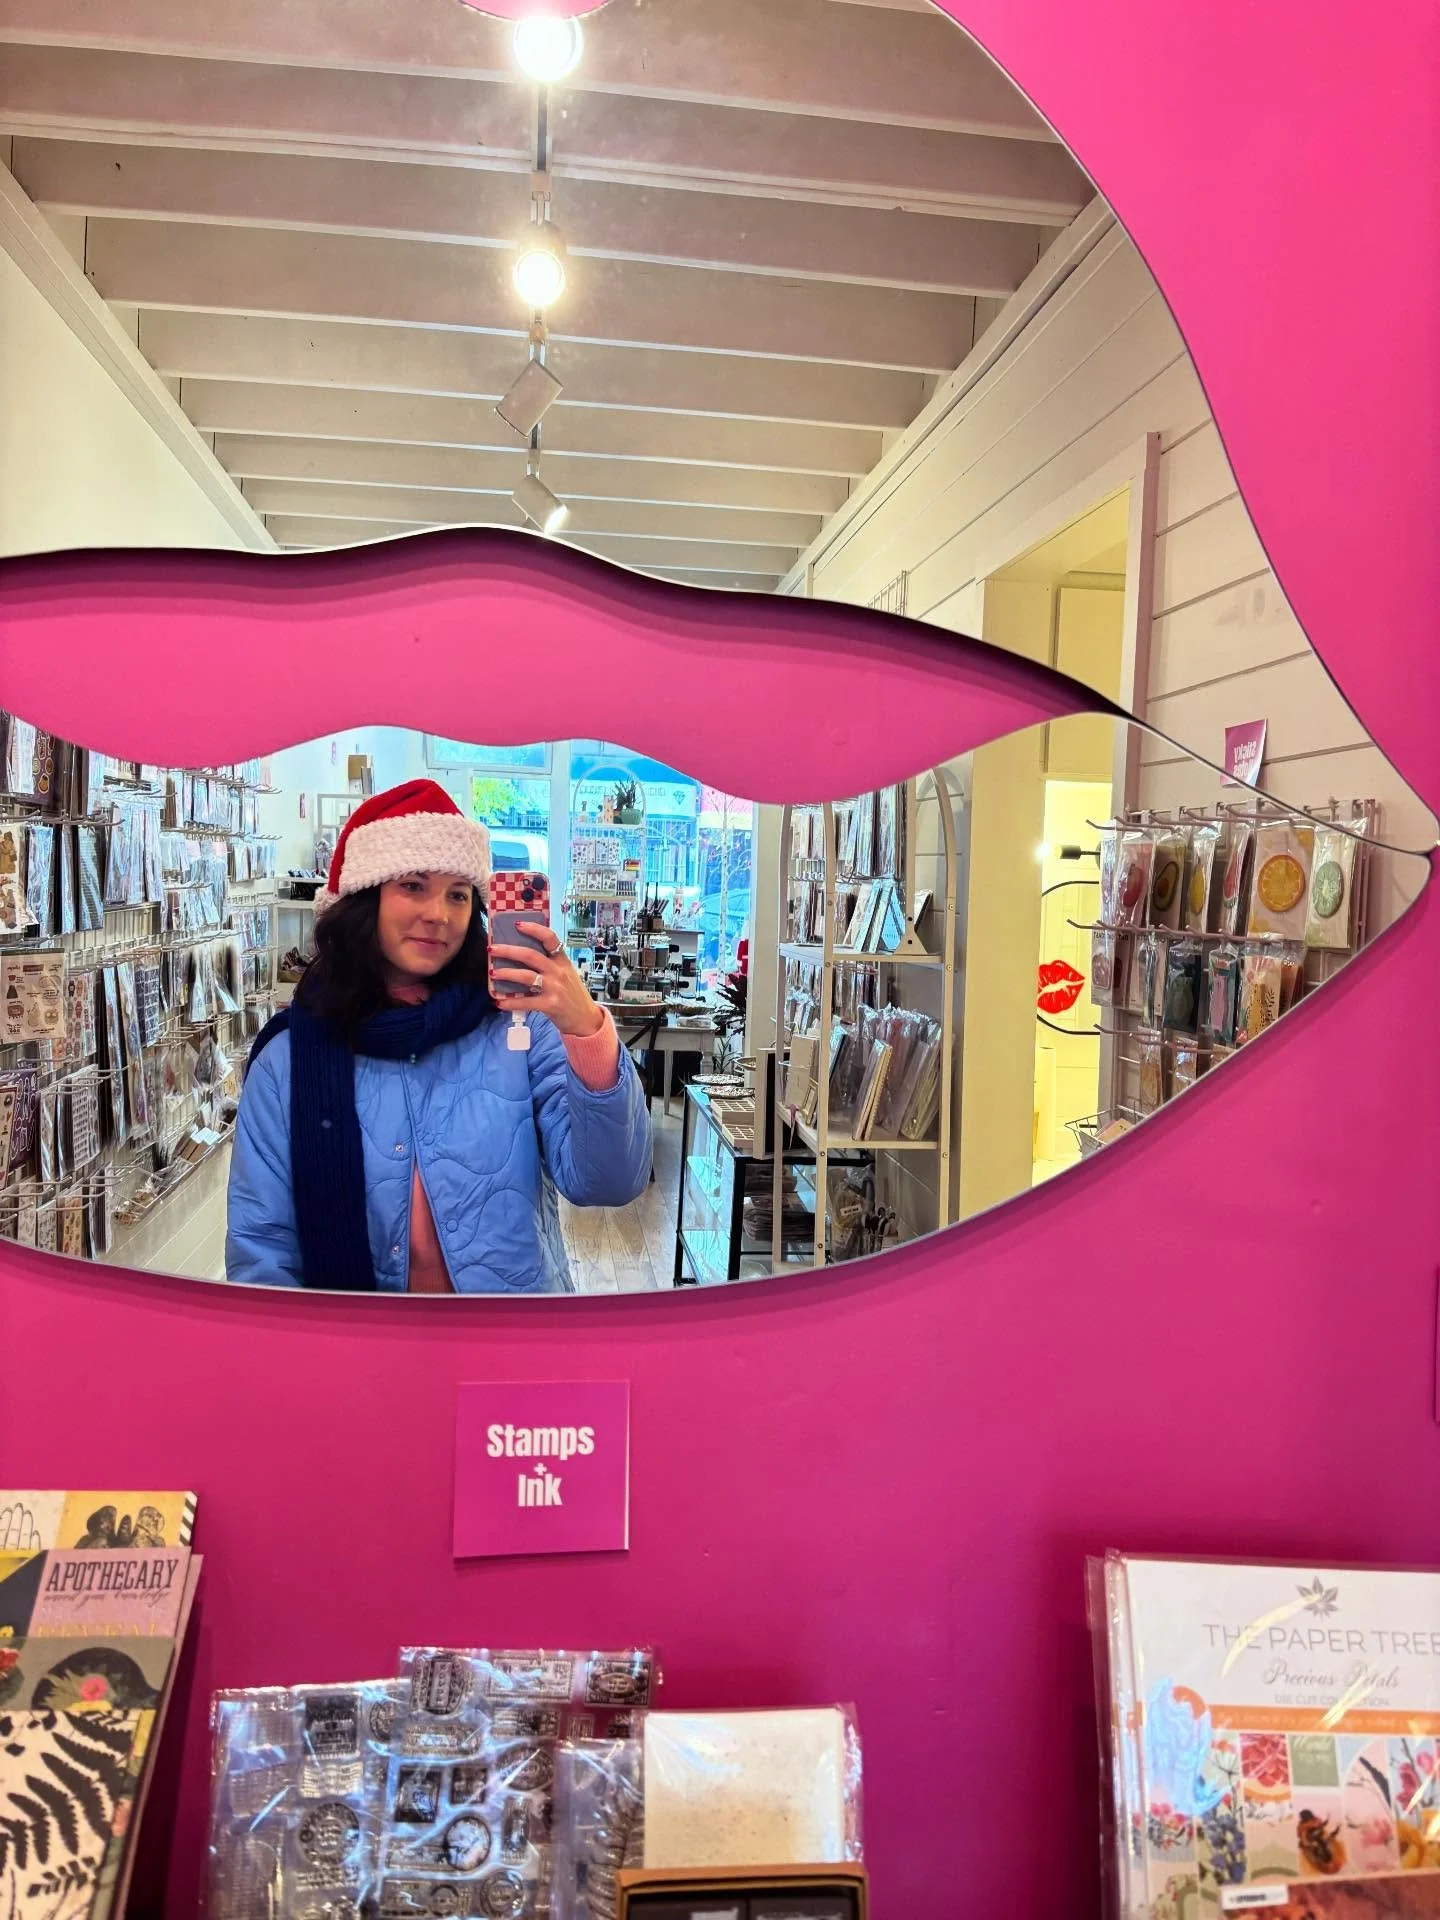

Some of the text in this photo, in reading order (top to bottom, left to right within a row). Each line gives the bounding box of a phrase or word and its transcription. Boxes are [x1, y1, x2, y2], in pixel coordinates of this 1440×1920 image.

[486, 1423, 596, 1461] Stamps
[533, 1462, 548, 1476] +
[517, 1473, 563, 1507] Ink
[45, 1559, 179, 1592] APOTHECARY
[1201, 1623, 1262, 1650] THE
[1267, 1626, 1367, 1653] PAPER
[1260, 1655, 1400, 1688] Precious Petals
